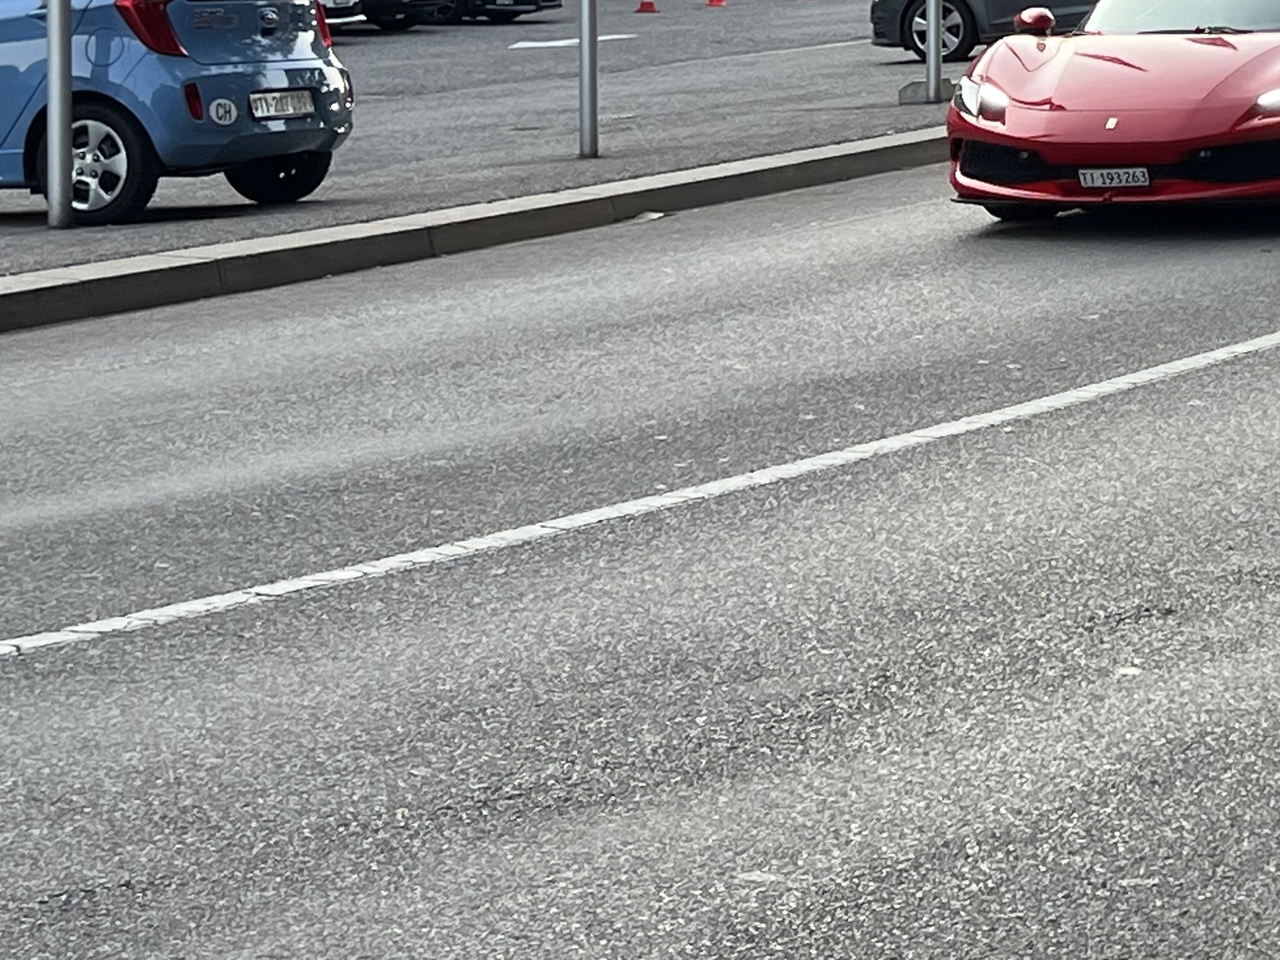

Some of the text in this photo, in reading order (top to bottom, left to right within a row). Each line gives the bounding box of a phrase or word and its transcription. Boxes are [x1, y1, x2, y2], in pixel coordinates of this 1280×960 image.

[215, 101, 233, 122] CH
[1081, 170, 1147, 185] TI 193263
